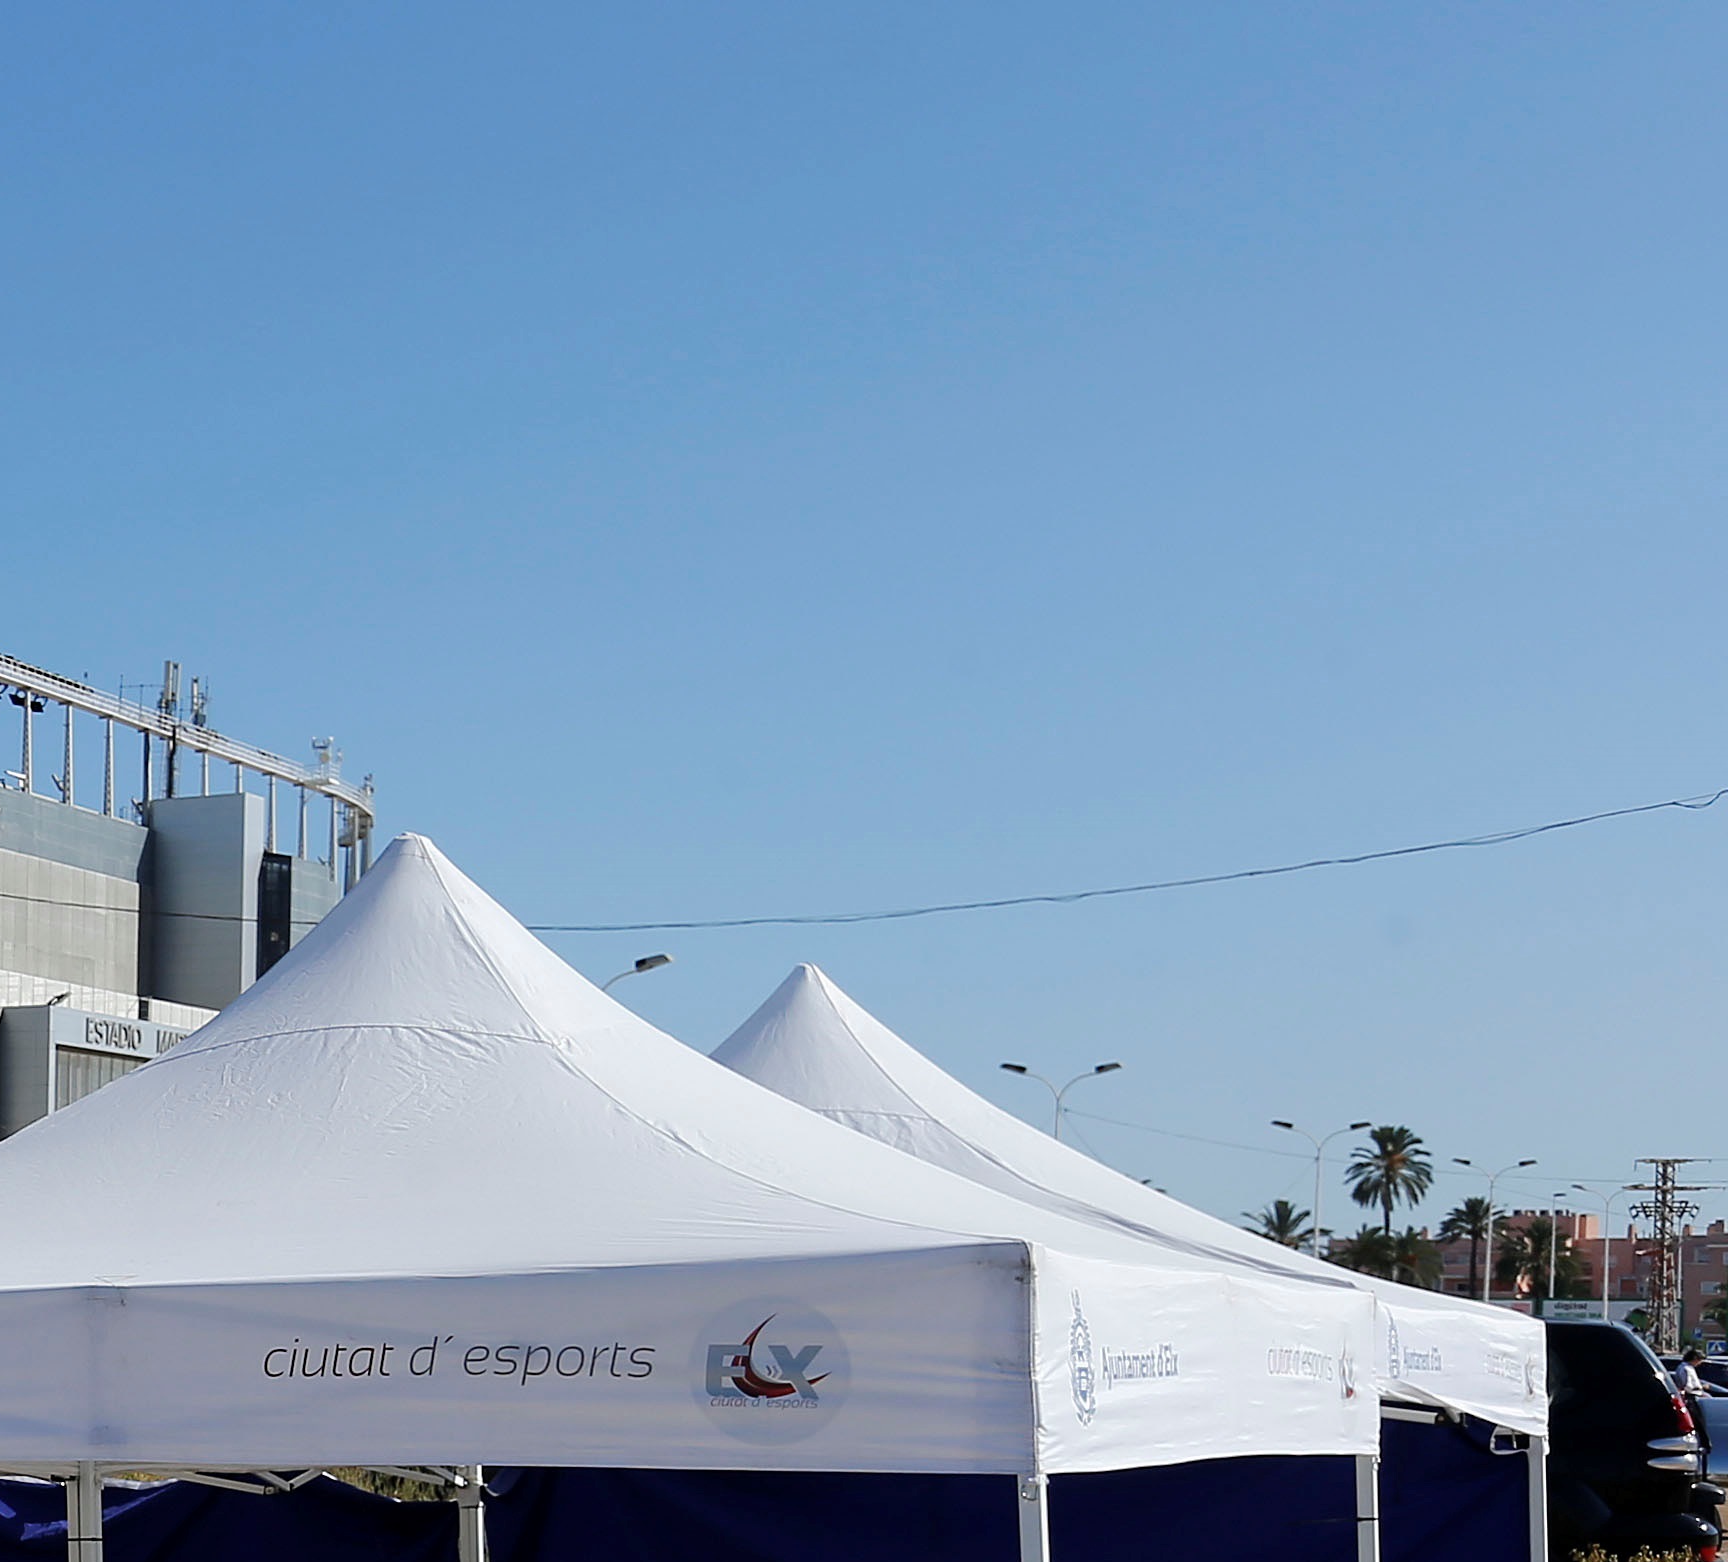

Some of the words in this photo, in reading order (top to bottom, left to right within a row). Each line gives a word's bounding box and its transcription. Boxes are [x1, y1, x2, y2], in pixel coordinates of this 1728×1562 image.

[85, 1017, 142, 1050] ESTADIO
[263, 1337, 394, 1378] ciutat
[461, 1339, 656, 1386] esports
[1101, 1346, 1156, 1390] Ajuntament
